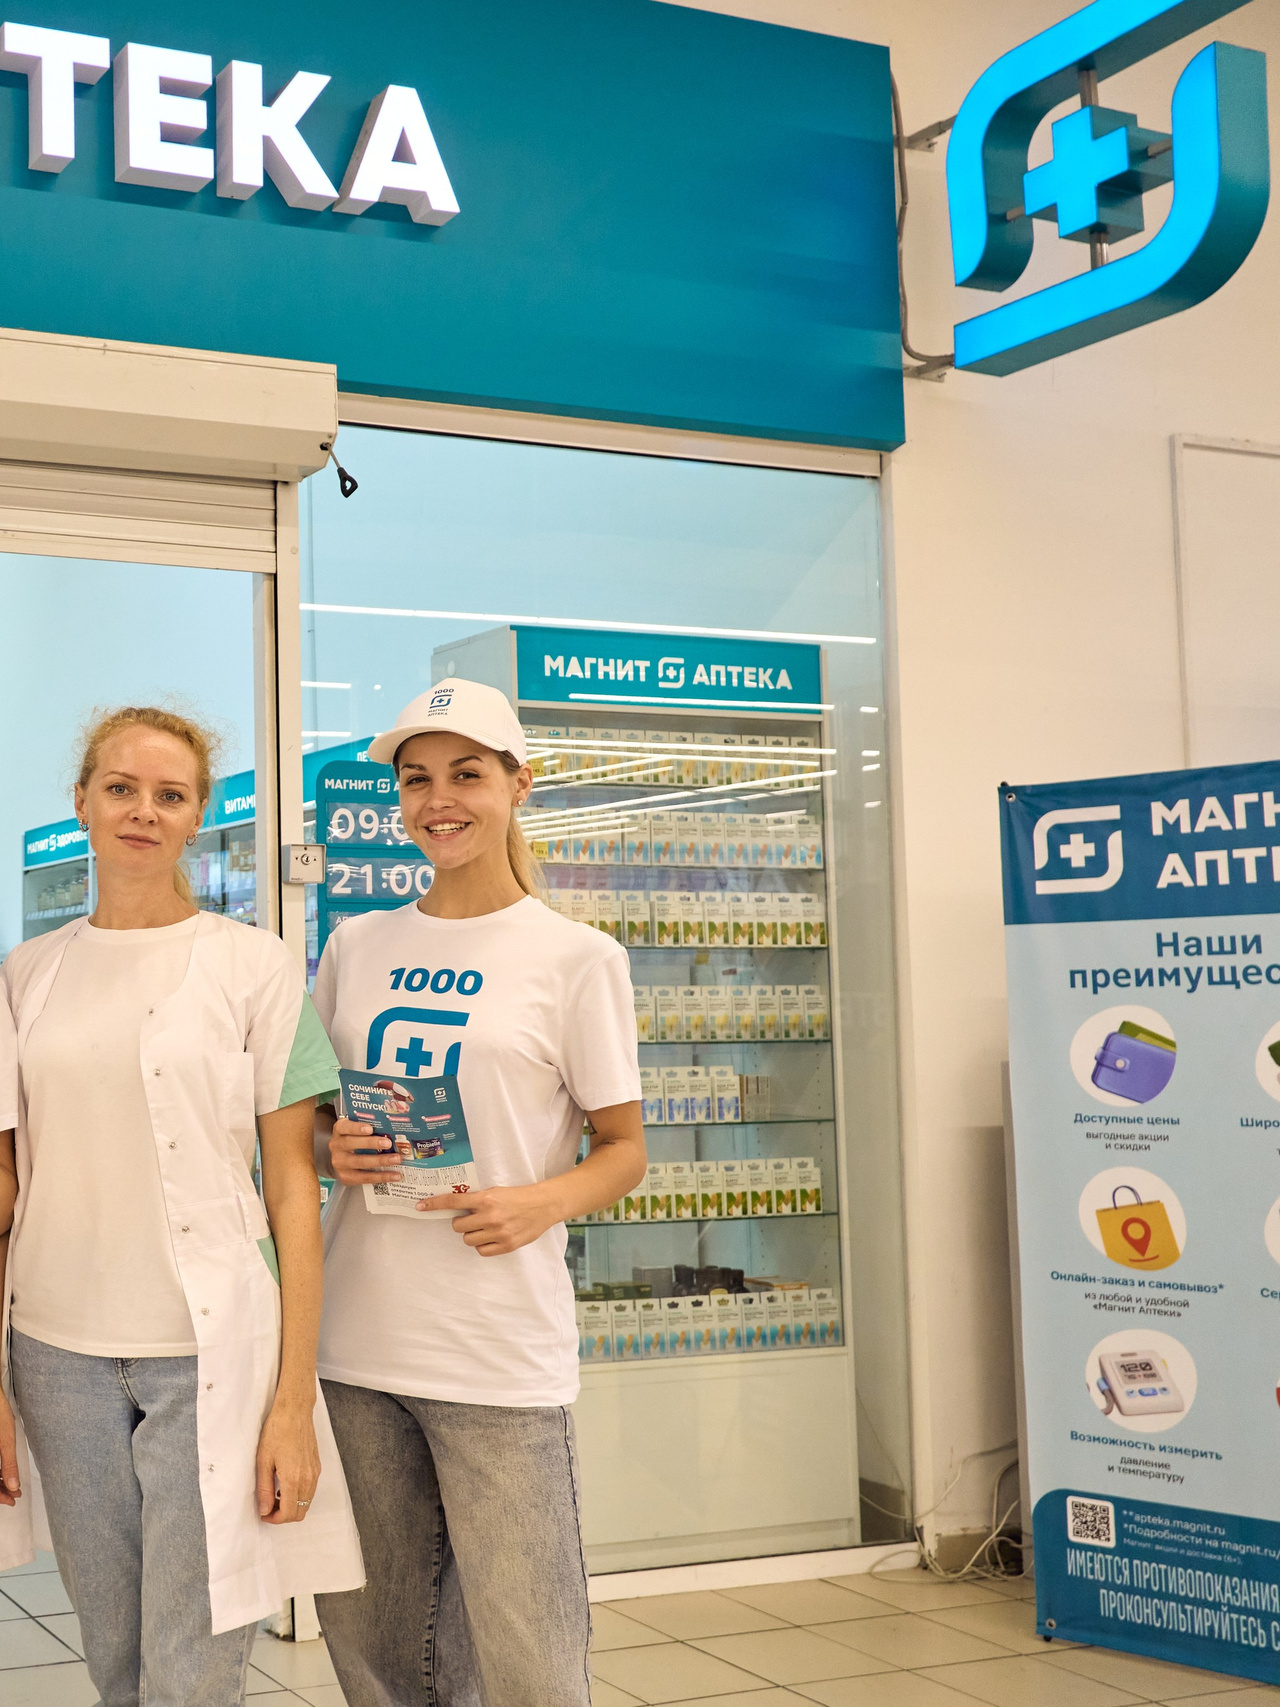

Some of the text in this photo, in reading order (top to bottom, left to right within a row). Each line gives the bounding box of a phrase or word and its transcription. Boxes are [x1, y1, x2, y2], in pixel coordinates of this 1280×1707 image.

[544, 655, 793, 690] МАГНИТ АПТЕКА
[325, 778, 374, 791] МАГНИТ
[331, 863, 435, 896] 21:00
[1156, 932, 1262, 957] Наши
[389, 967, 483, 996] 1000
[350, 1092, 370, 1101] СЕБЕ
[1074, 1113, 1180, 1126] Доступные цены
[1086, 1131, 1169, 1142] выгодные акции
[1114, 1143, 1151, 1151] скидки
[1051, 1271, 1135, 1287] Онлайн-заказ
[1085, 1292, 1096, 1300] из
[1099, 1292, 1132, 1304] любой
[1145, 1296, 1189, 1308] удобной
[1120, 1361, 1153, 1373] 120
[1070, 1431, 1223, 1462] Возможность измерить
[1120, 1456, 1170, 1470] давление
[1118, 1465, 1185, 1485] температуру
[1205, 1538, 1219, 1549] на
[1067, 1548, 1129, 1586] ИМЕЮТСЯ
[1100, 1588, 1267, 1649] ПРОКОНСУЛЬТИРУЙТЕСЬ
